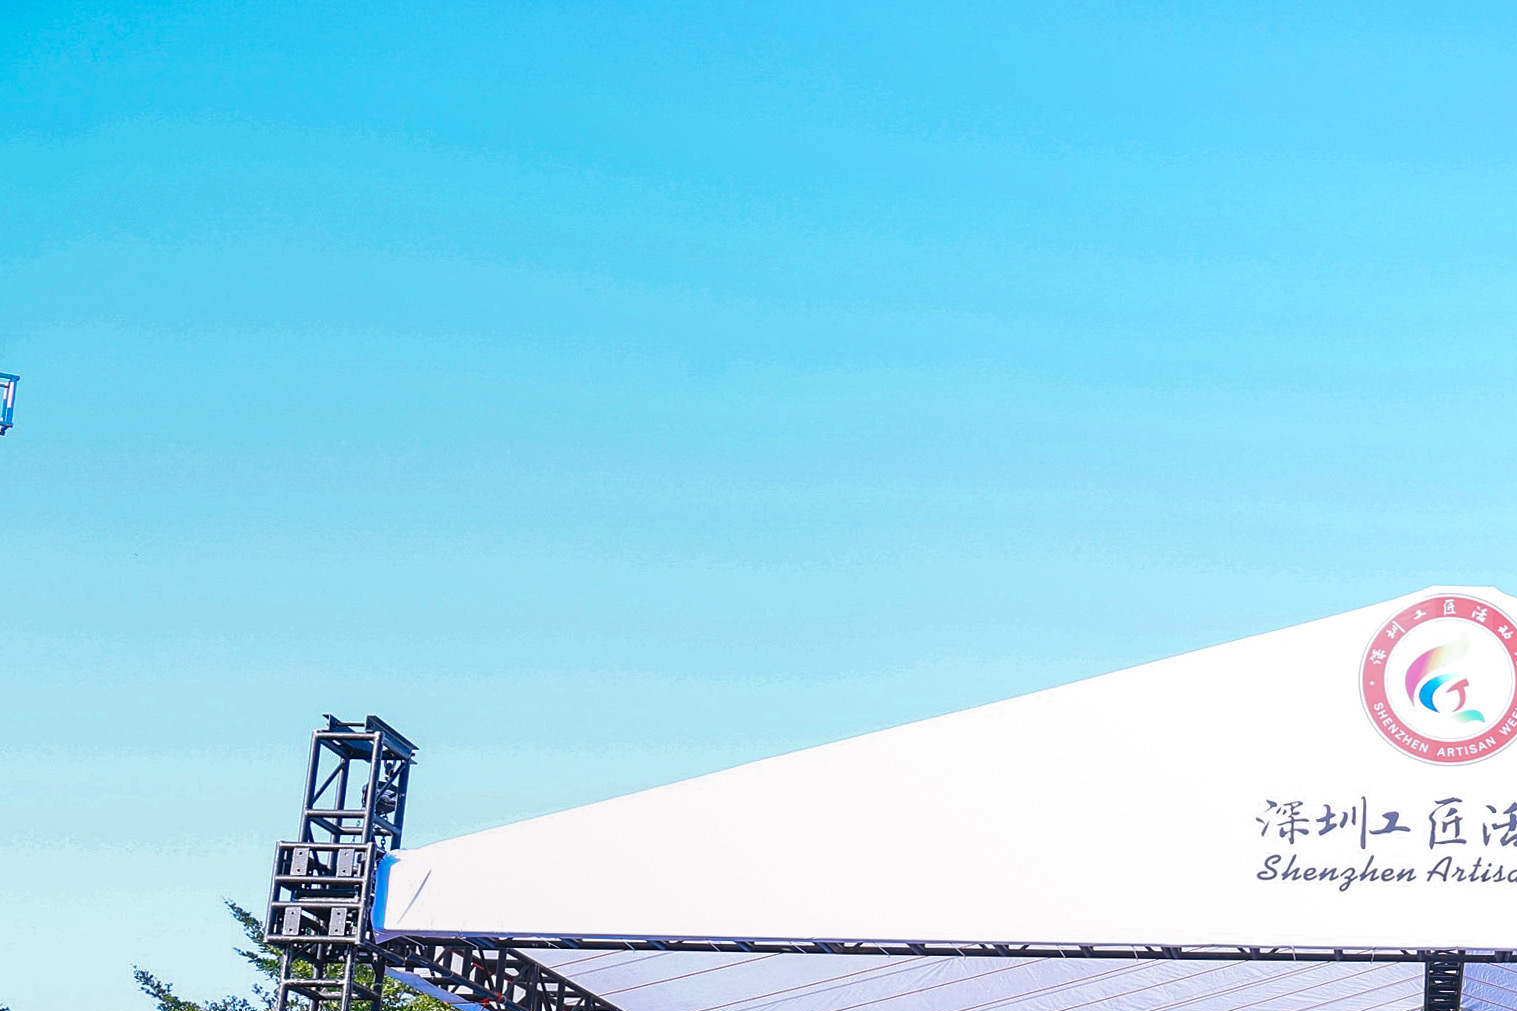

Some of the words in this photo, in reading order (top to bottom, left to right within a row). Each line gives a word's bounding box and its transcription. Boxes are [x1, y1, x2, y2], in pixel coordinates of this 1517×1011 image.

[1373, 701, 1429, 754] SHENZHEN
[1436, 735, 1497, 757] ARTISAN
[1256, 855, 1417, 892] Shenzhen
